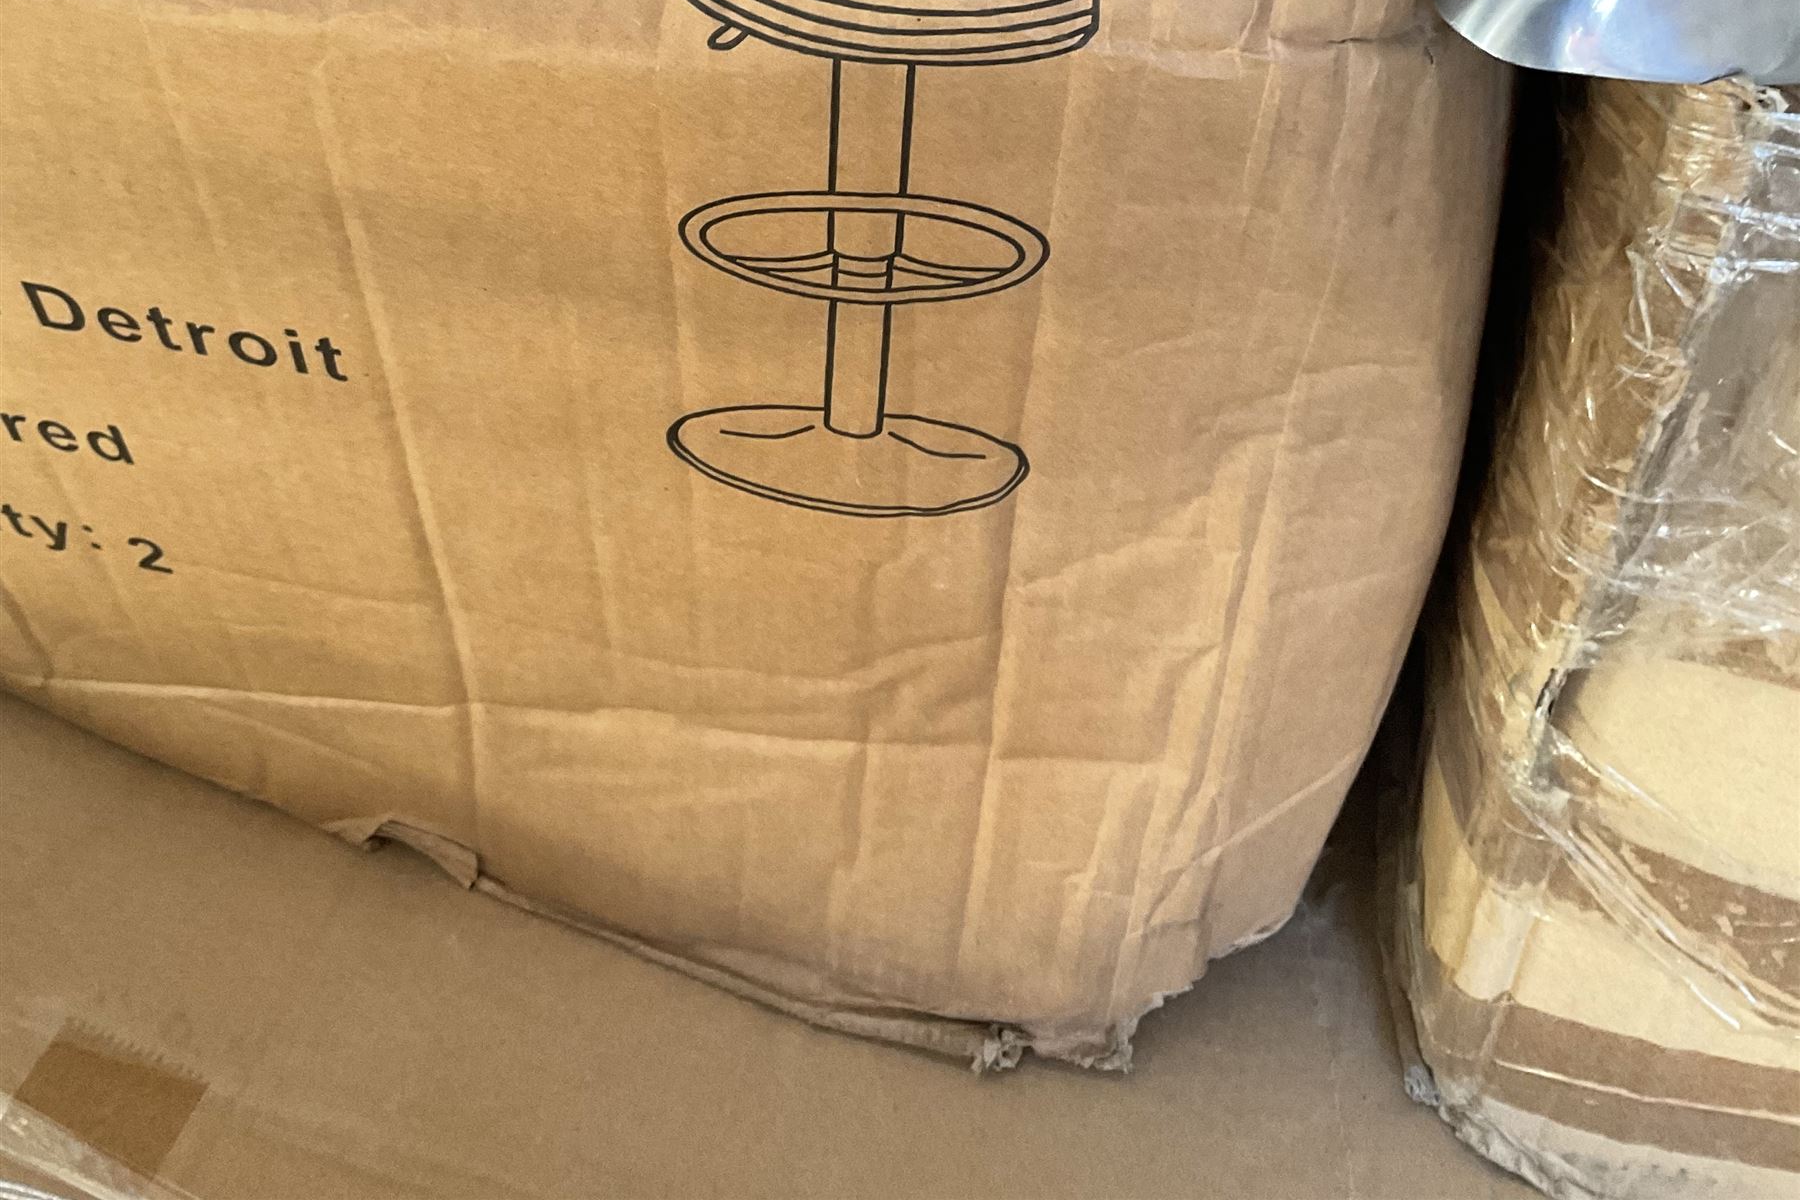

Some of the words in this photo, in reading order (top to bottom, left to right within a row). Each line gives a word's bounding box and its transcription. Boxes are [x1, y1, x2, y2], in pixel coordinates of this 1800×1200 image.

[21, 280, 349, 382] Detroit
[0, 412, 135, 465] red
[127, 536, 174, 574] 2
